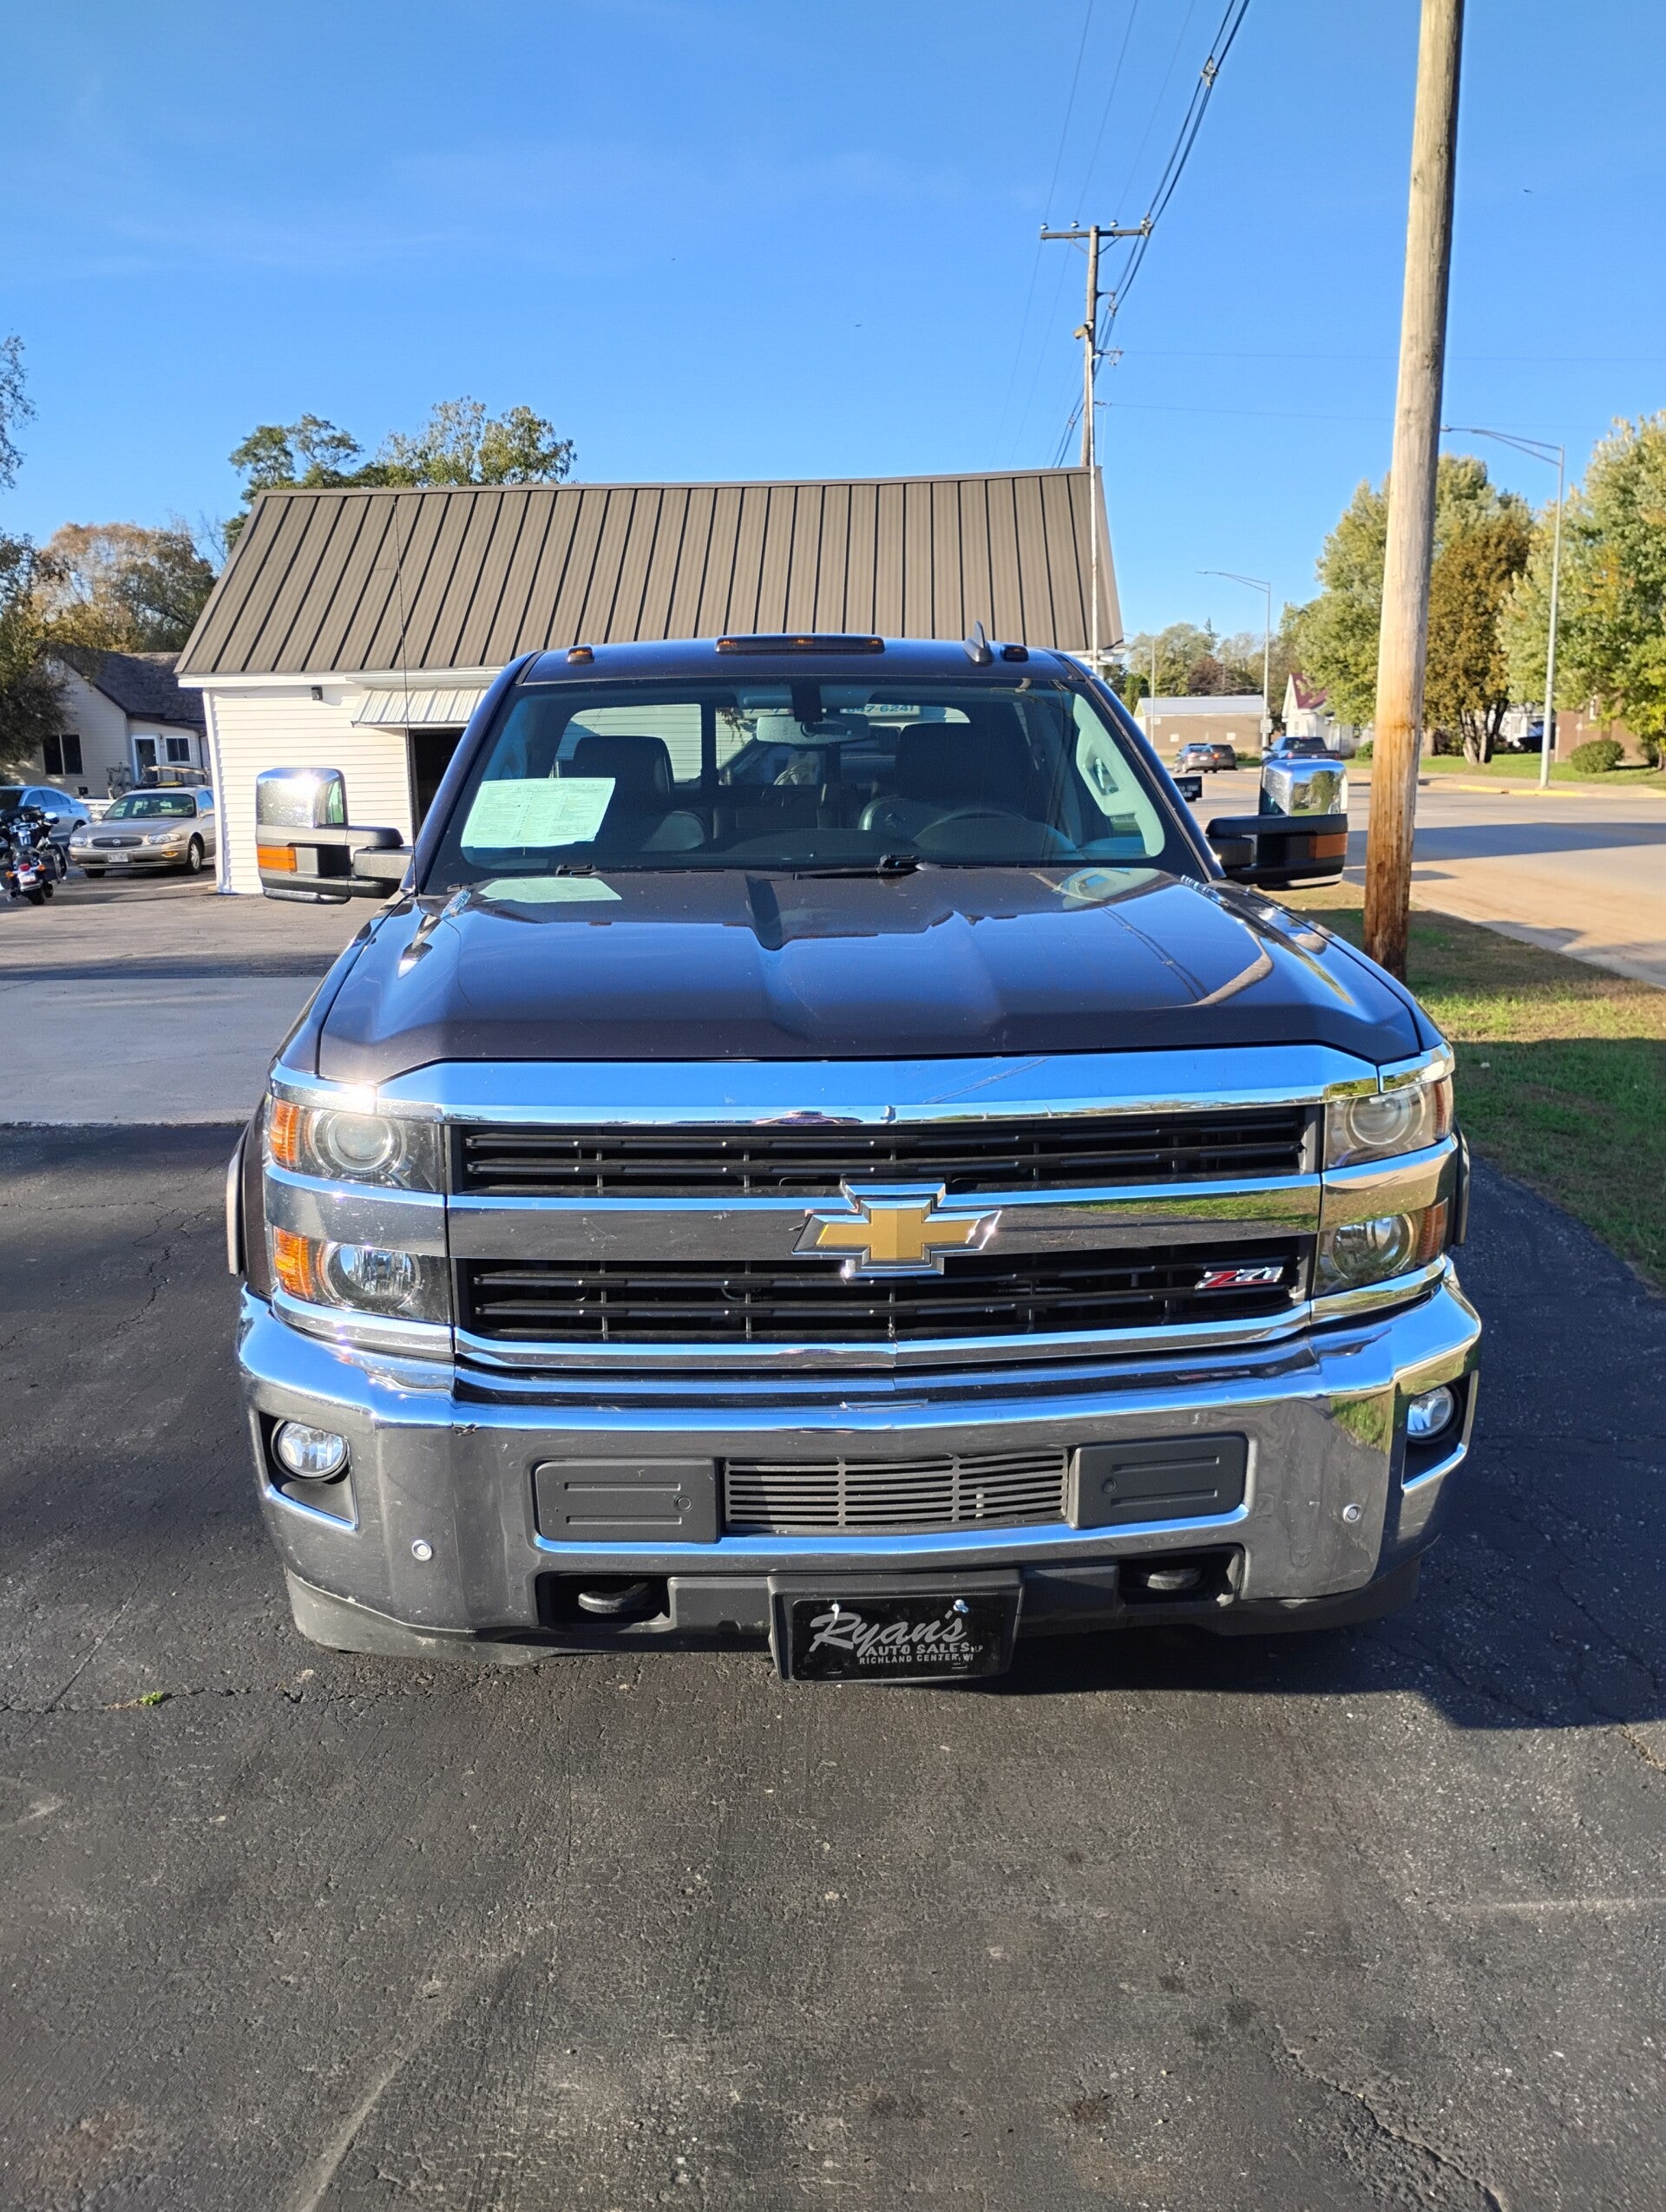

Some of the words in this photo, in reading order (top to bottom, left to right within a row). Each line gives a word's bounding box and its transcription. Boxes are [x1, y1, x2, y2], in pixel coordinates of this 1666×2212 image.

[1195, 1266, 1283, 1289] Z71
[809, 1611, 967, 1657] Ryan's
[865, 1645, 911, 1656] AUTO
[916, 1642, 970, 1654] SALES
[859, 1655, 913, 1665] RICHLAND
[962, 1653, 974, 1662] WI
